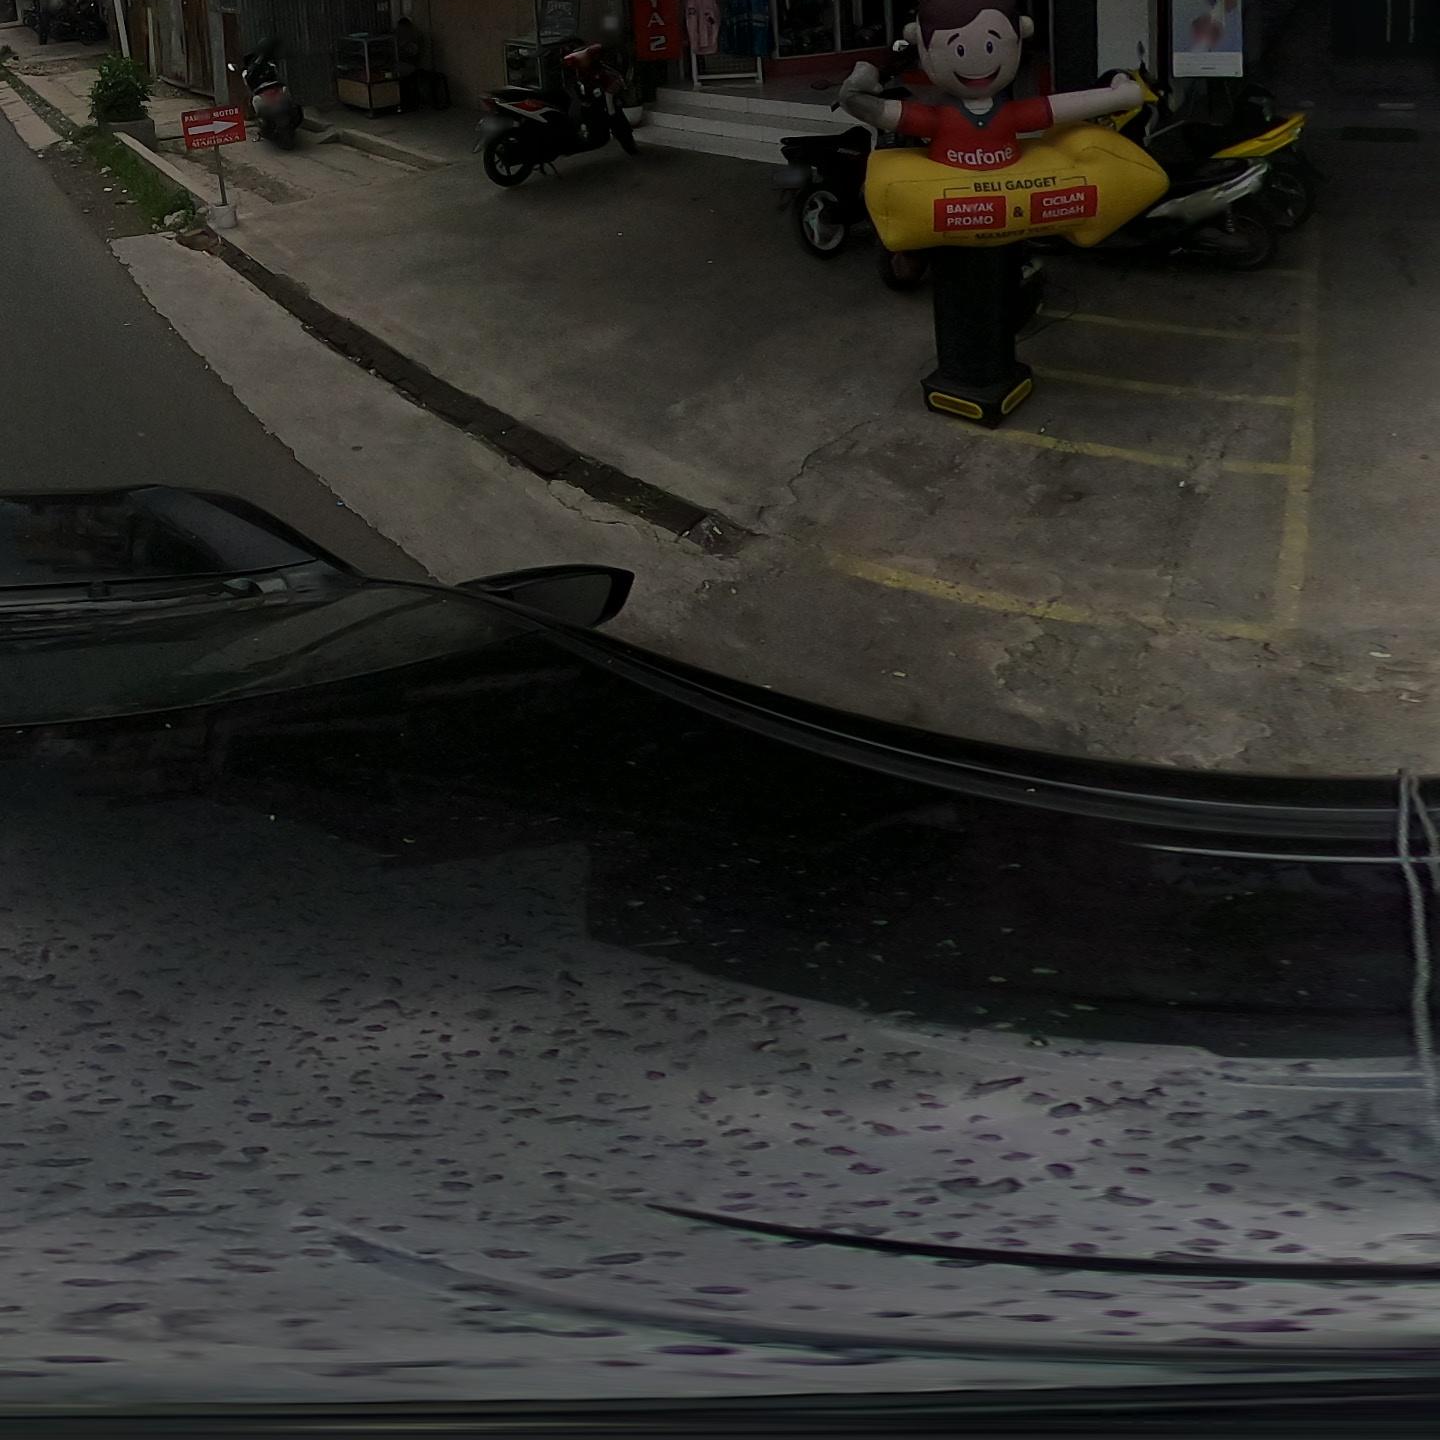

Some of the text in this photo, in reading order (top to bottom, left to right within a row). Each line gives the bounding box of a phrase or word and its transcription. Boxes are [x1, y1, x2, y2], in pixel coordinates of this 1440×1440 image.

[947, 146, 1014, 166] erafone
[973, 176, 1058, 193] BELI GADGET
[946, 215, 994, 226] PROMO
